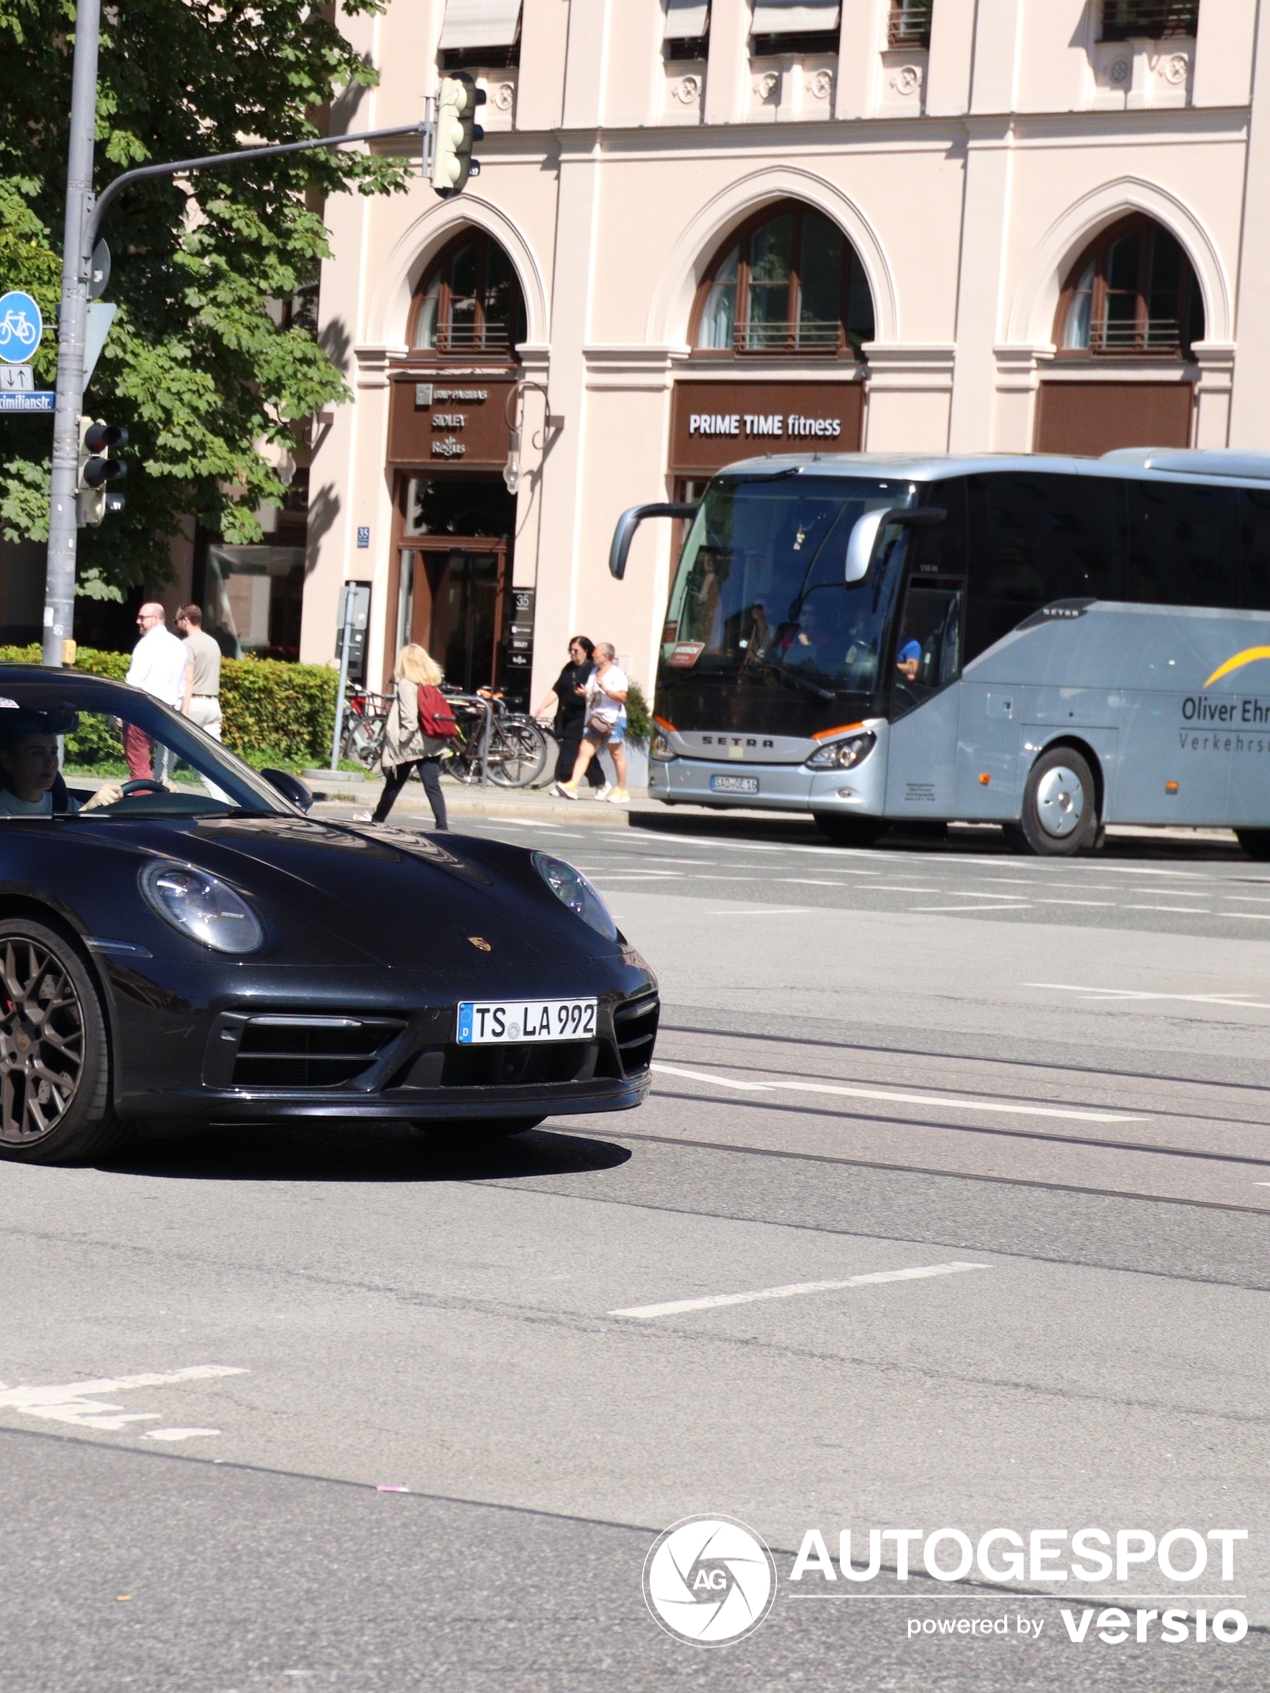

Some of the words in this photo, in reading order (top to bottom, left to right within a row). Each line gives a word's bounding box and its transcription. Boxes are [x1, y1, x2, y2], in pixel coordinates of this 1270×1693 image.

[434, 390, 451, 399] BNP
[452, 390, 488, 400] PARIBAS
[432, 414, 465, 427] SIDLEY
[689, 414, 740, 435] PRIME
[744, 415, 783, 435] TIME
[787, 415, 841, 436] fitness
[432, 439, 466, 456] Regus
[516, 594, 529, 606] 35
[1182, 697, 1237, 723] Oliver
[702, 736, 774, 748] SETRA
[462, 1027, 468, 1037] D
[476, 1007, 506, 1038] TS
[523, 1006, 551, 1036] LA
[558, 1004, 594, 1035] 992
